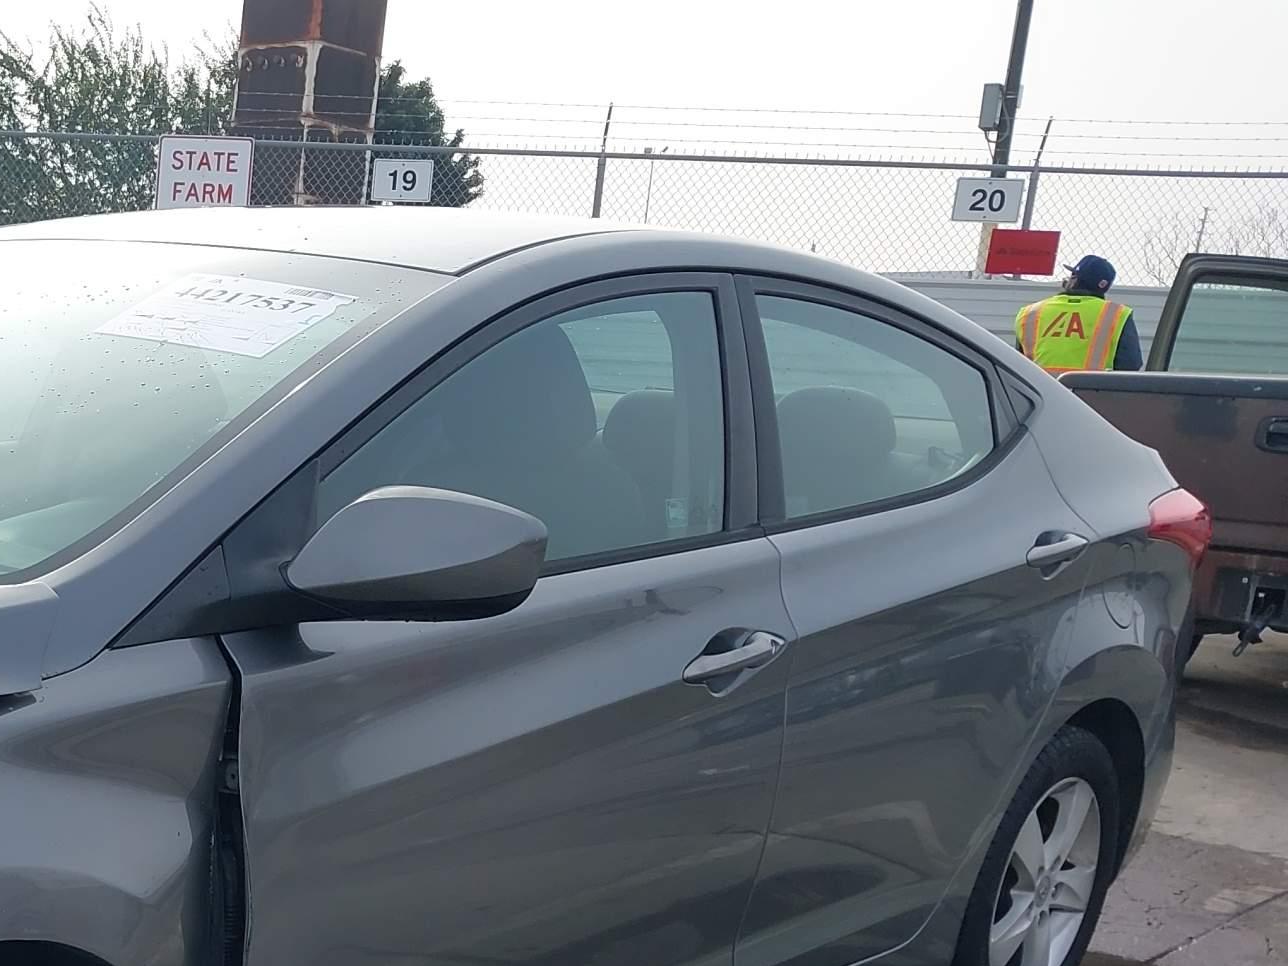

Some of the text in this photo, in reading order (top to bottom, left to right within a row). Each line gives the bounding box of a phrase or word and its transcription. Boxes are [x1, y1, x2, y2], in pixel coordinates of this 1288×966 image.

[171, 150, 239, 173] STATE
[388, 170, 417, 191] 19
[172, 182, 233, 204] FARM
[968, 189, 1006, 212] 20
[175, 286, 317, 314] 44217537
